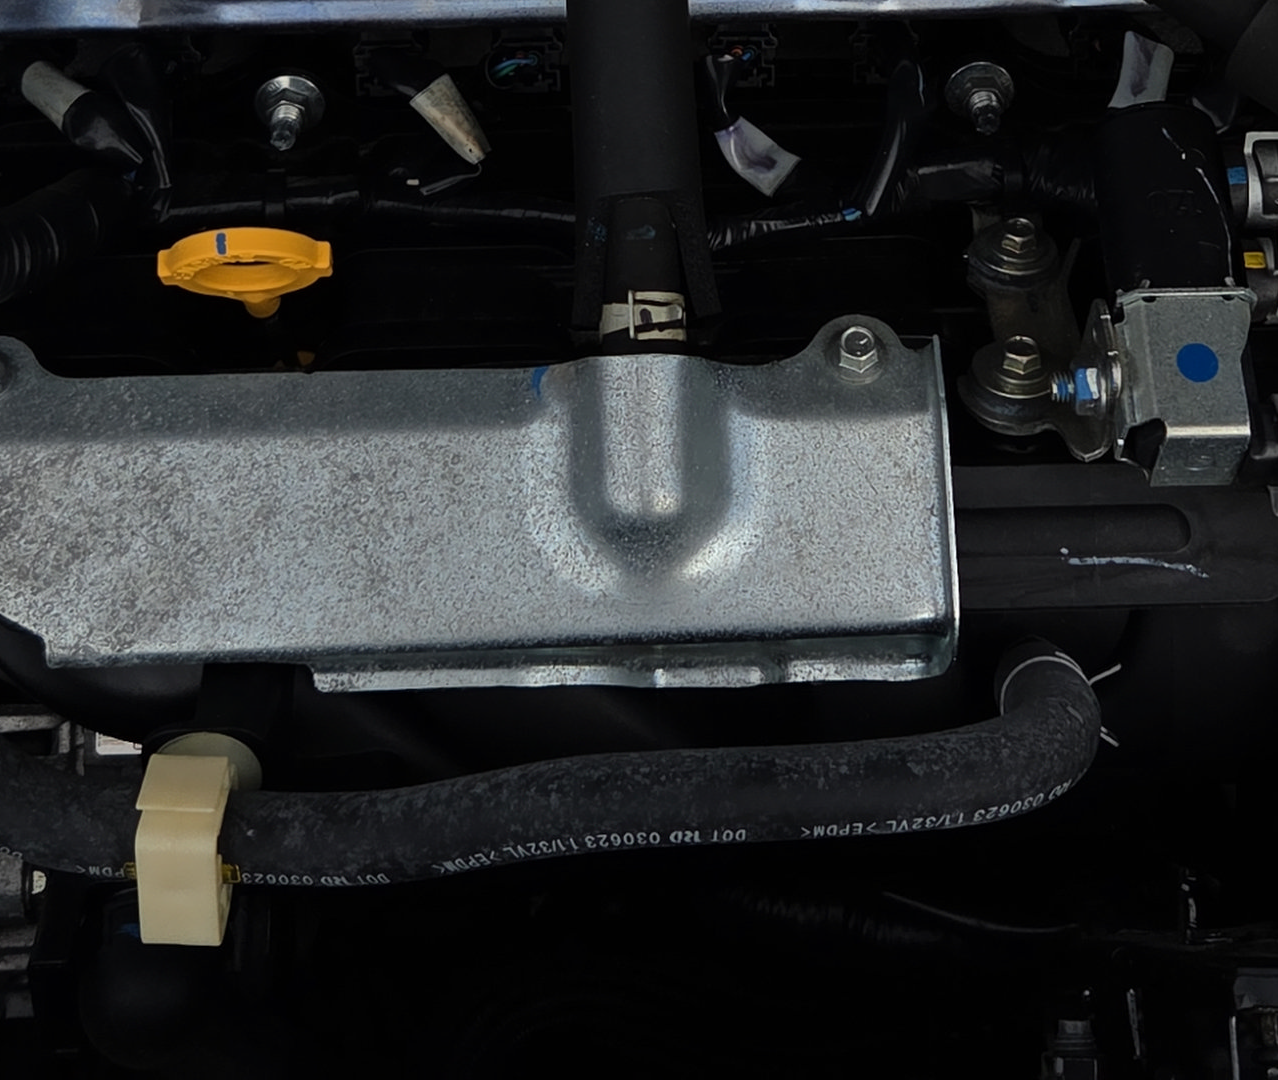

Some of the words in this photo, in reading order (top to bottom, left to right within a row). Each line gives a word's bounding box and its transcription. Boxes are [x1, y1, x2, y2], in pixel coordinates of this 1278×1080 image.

[972, 791, 1045, 824] 030623
[711, 828, 747, 842] DOT
[799, 821, 876, 838] >EPDM<
[584, 831, 661, 850] 030623
[241, 871, 314, 886] 030623
[357, 872, 392, 886] DOT
